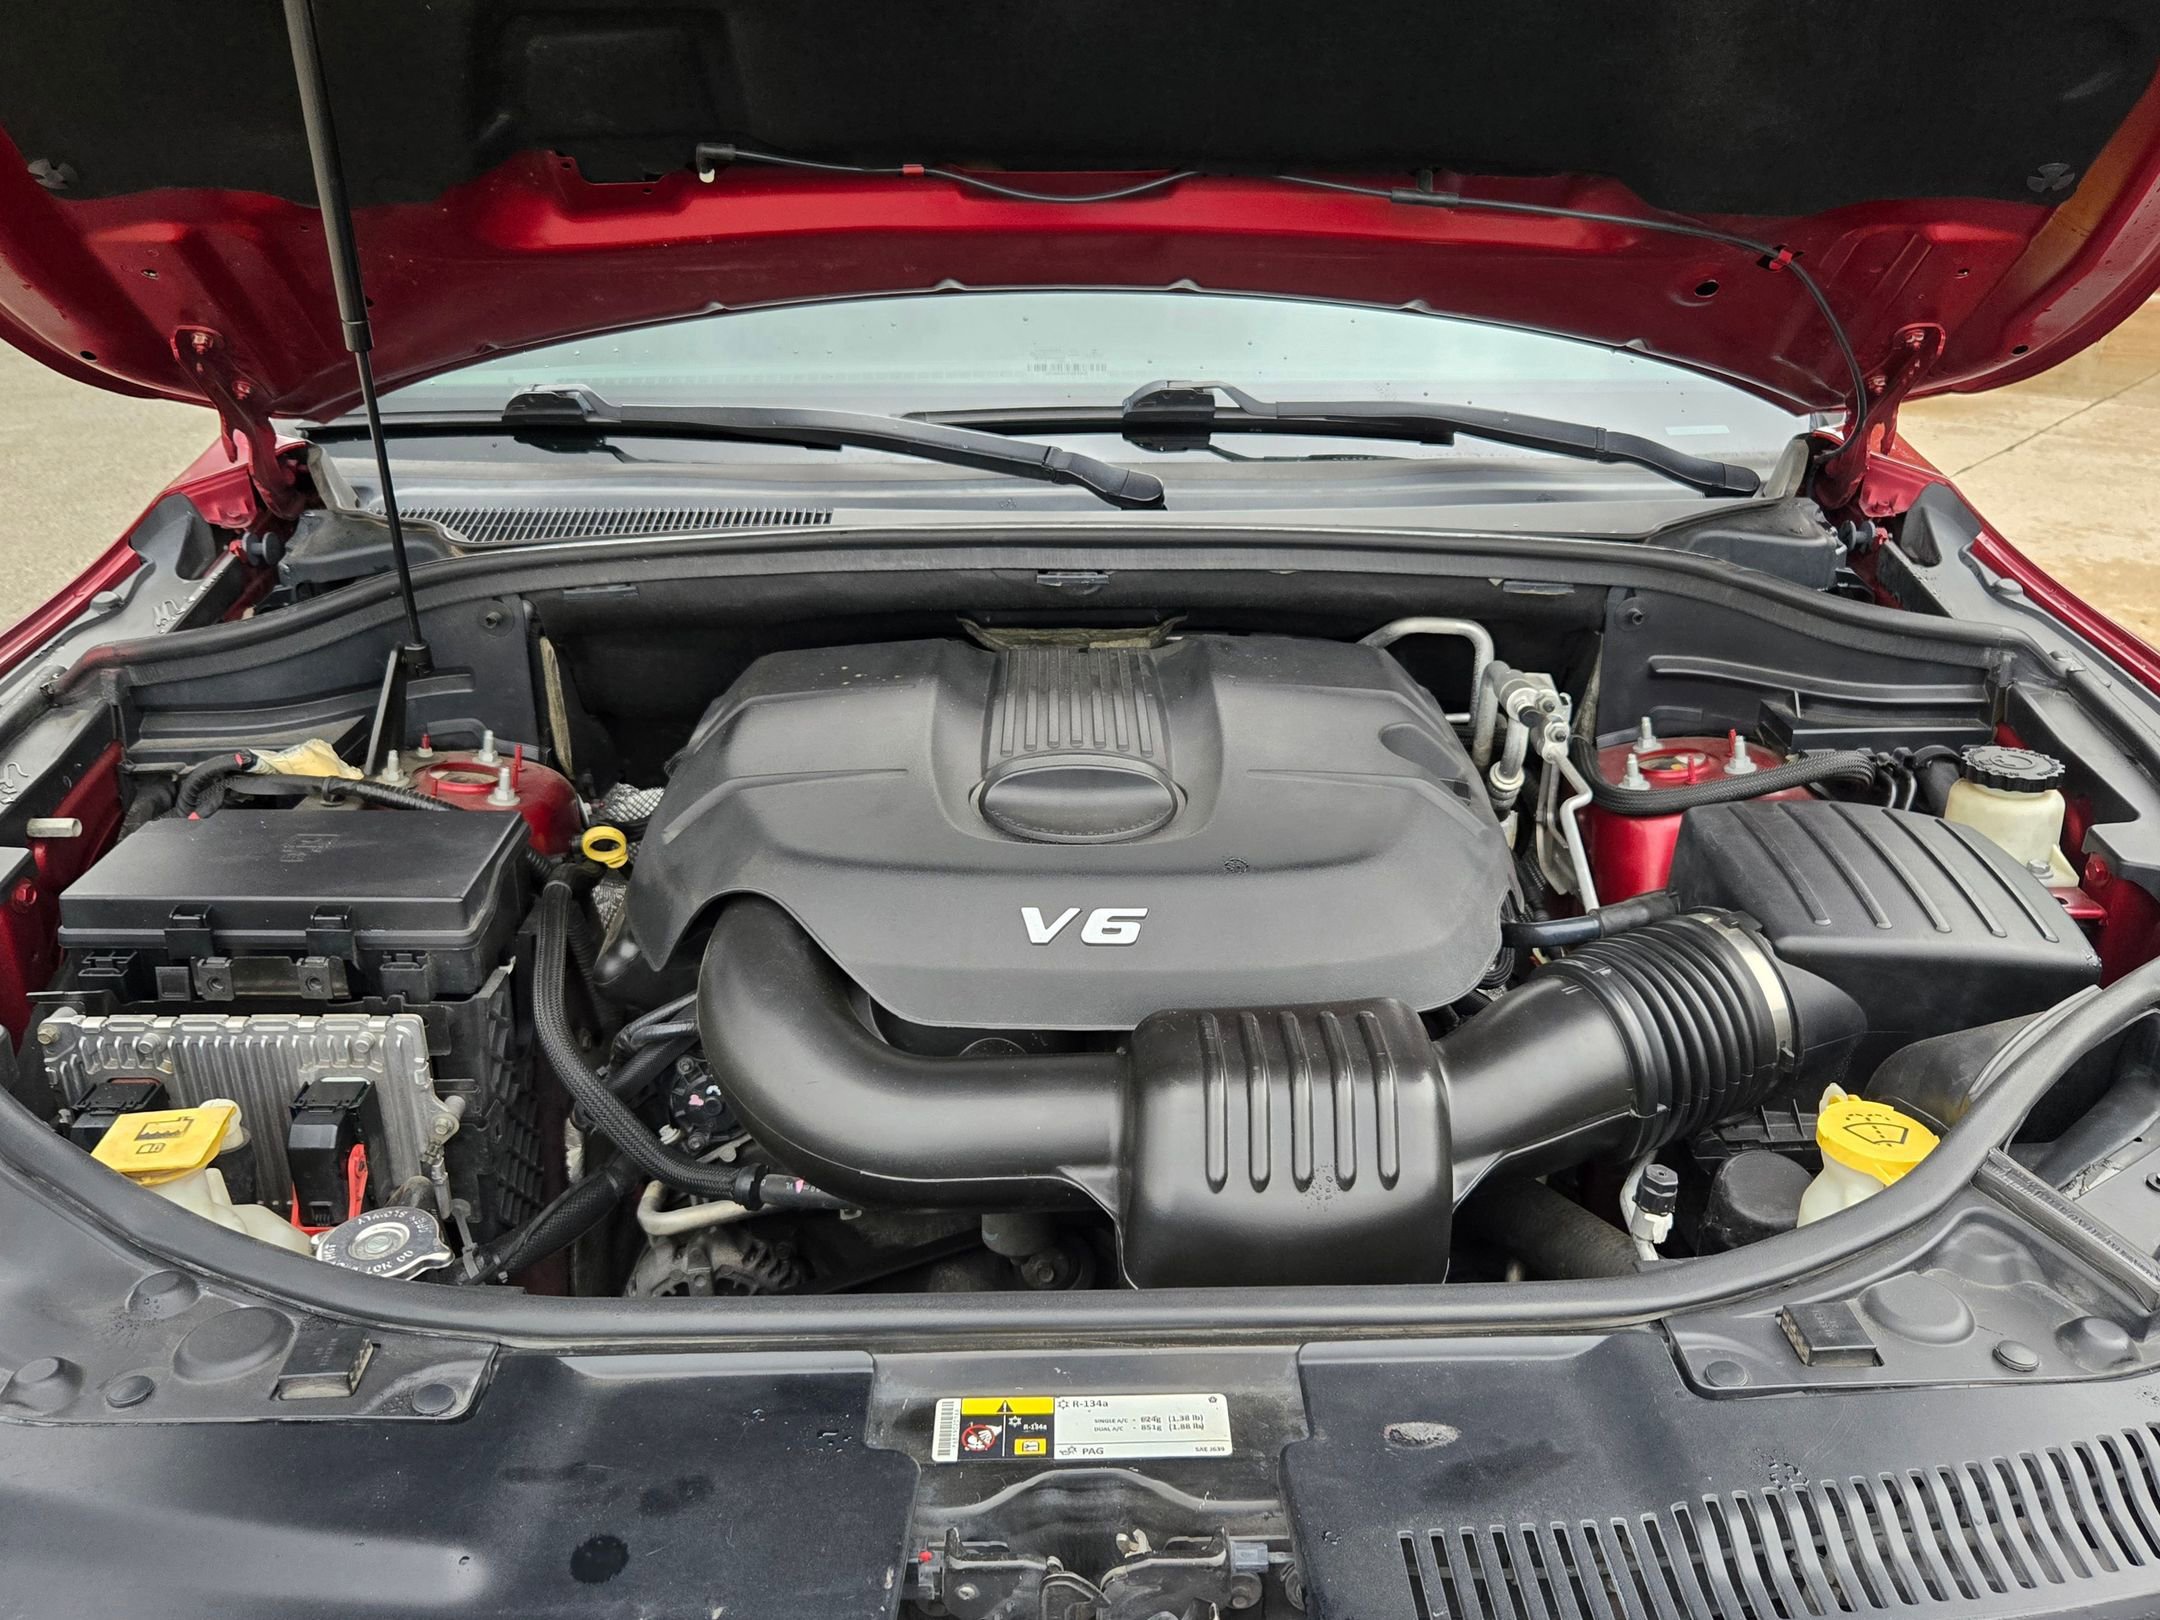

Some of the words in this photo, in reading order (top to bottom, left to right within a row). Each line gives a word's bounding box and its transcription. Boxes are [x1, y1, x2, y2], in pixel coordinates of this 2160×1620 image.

[1020, 907, 1149, 946] V6
[1072, 1399, 1109, 1408] R-134a
[1082, 1447, 1104, 1455] PAG
